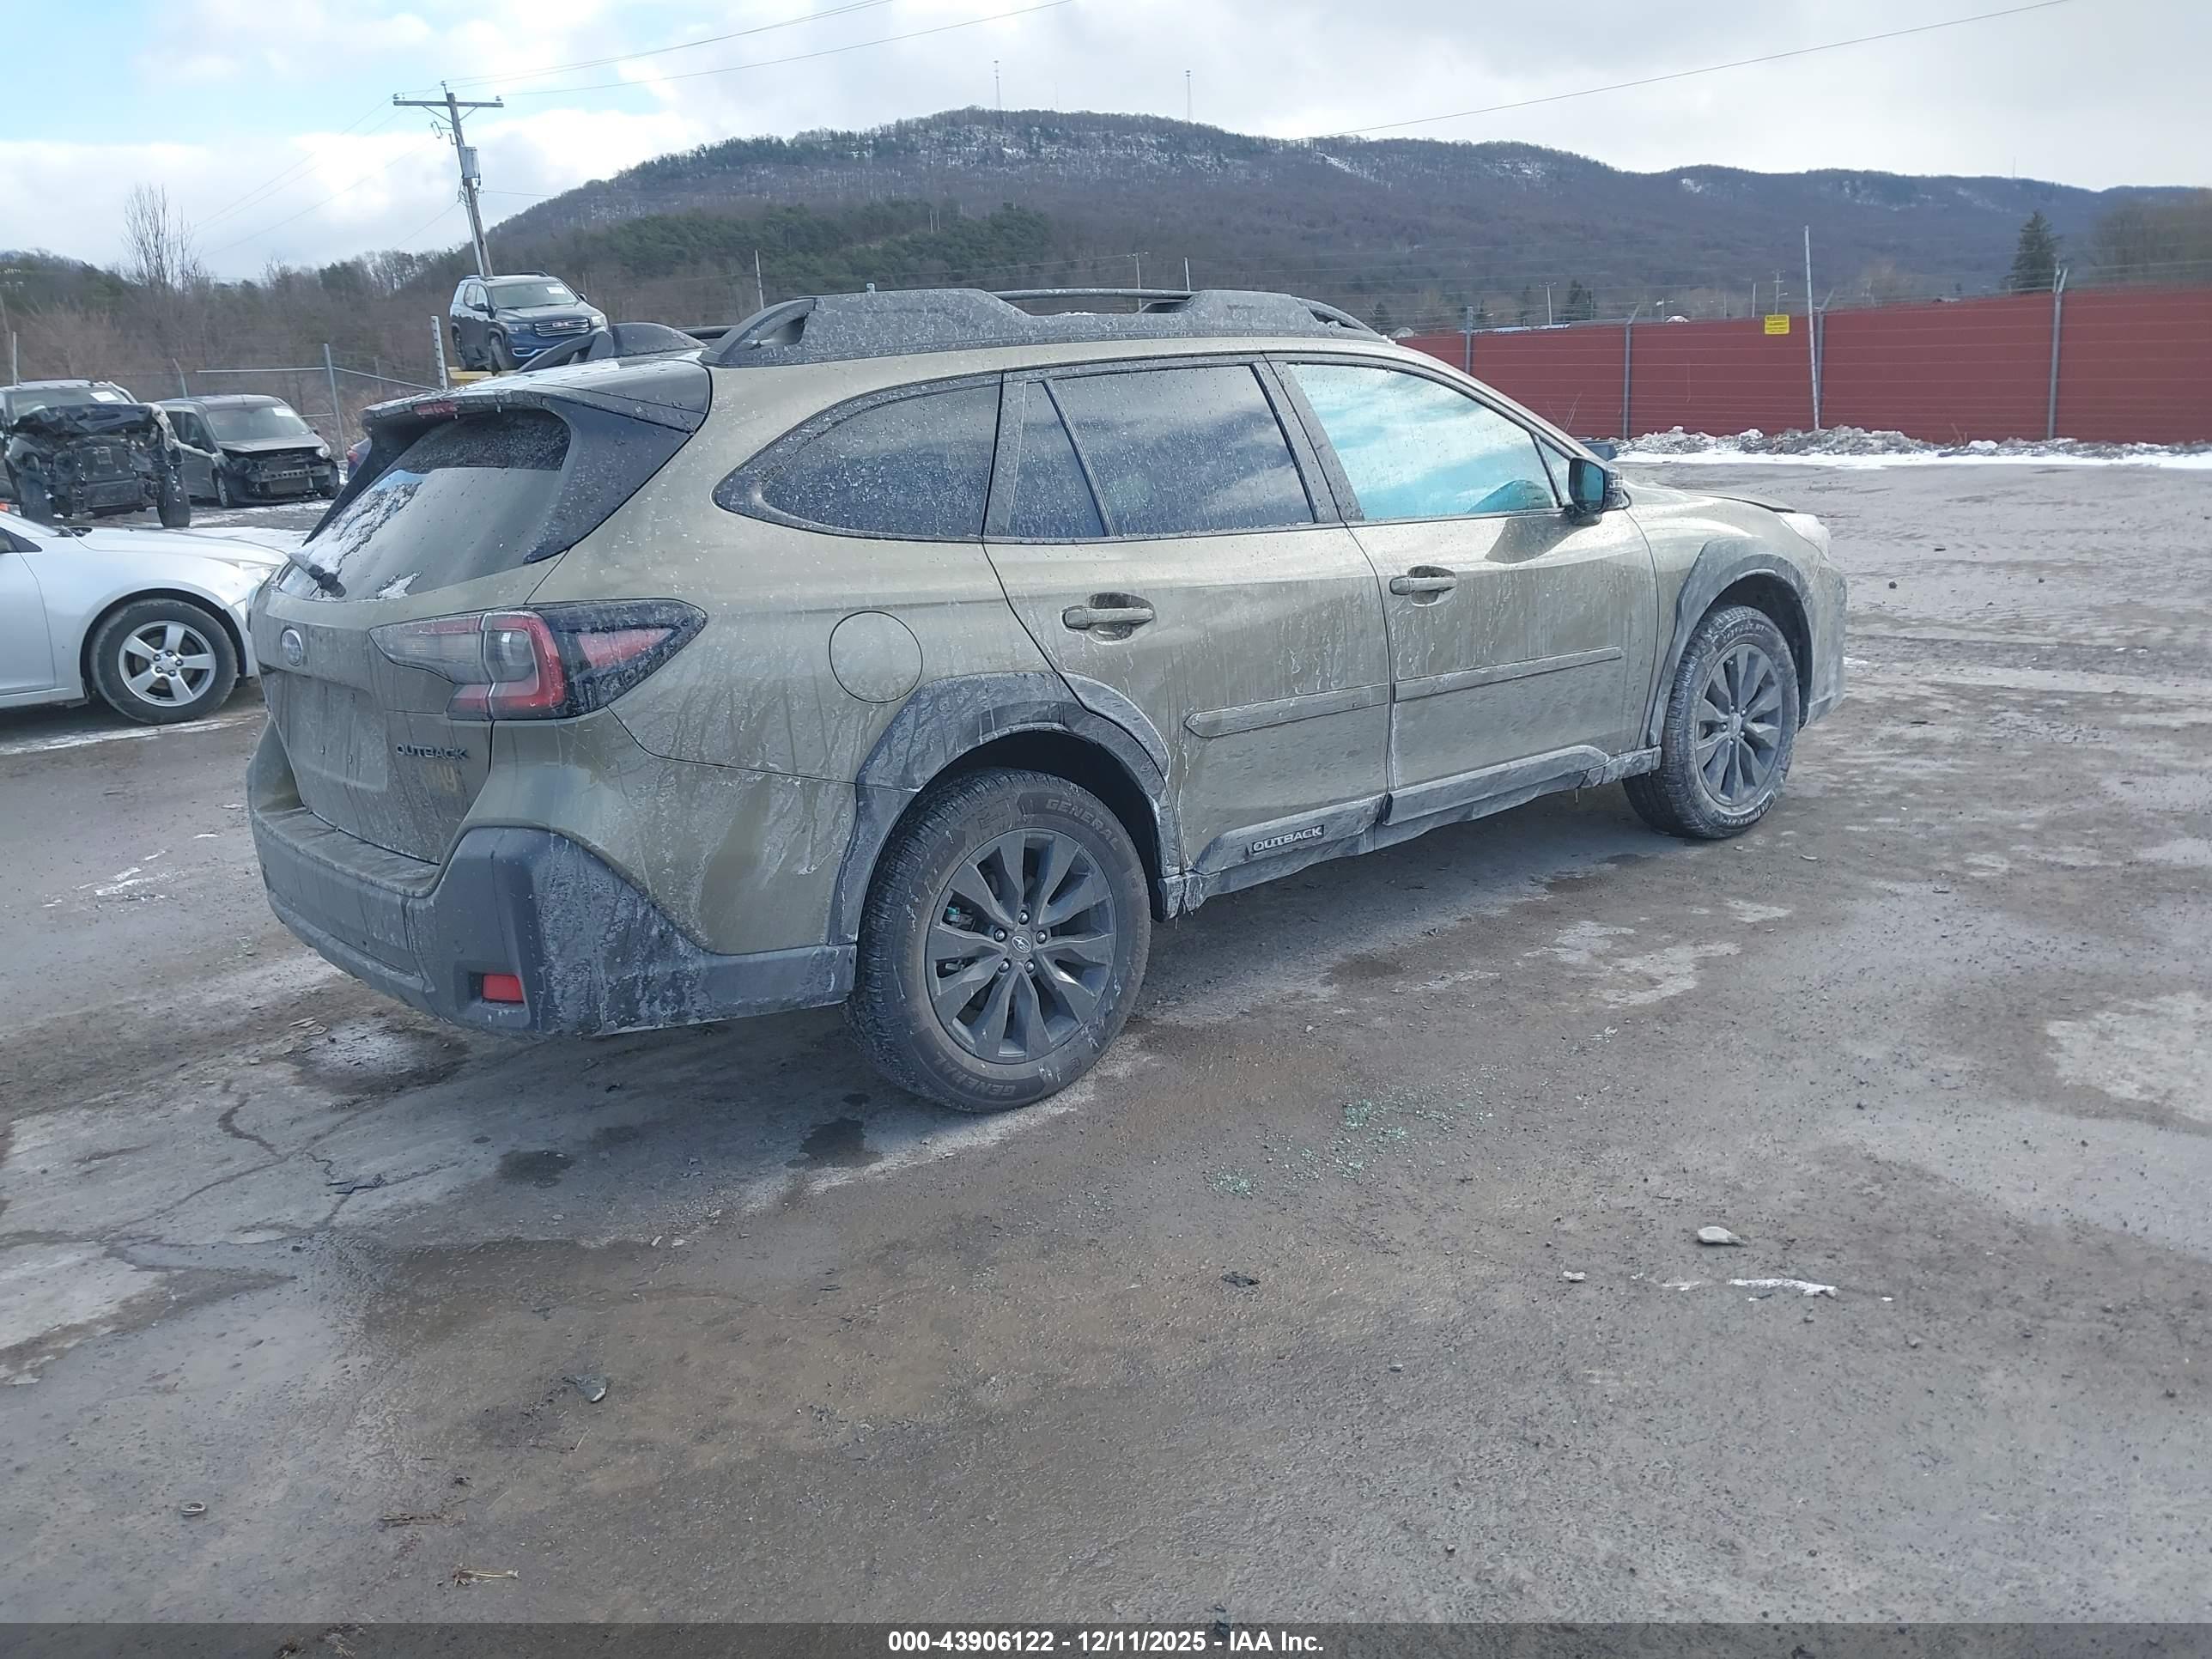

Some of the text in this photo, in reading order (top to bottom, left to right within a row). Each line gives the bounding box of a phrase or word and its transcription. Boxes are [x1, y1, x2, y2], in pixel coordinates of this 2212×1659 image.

[396, 743, 469, 760] OUTBACK
[1045, 799, 1118, 851] GENERAL
[1253, 826, 1322, 852] OUTBACK
